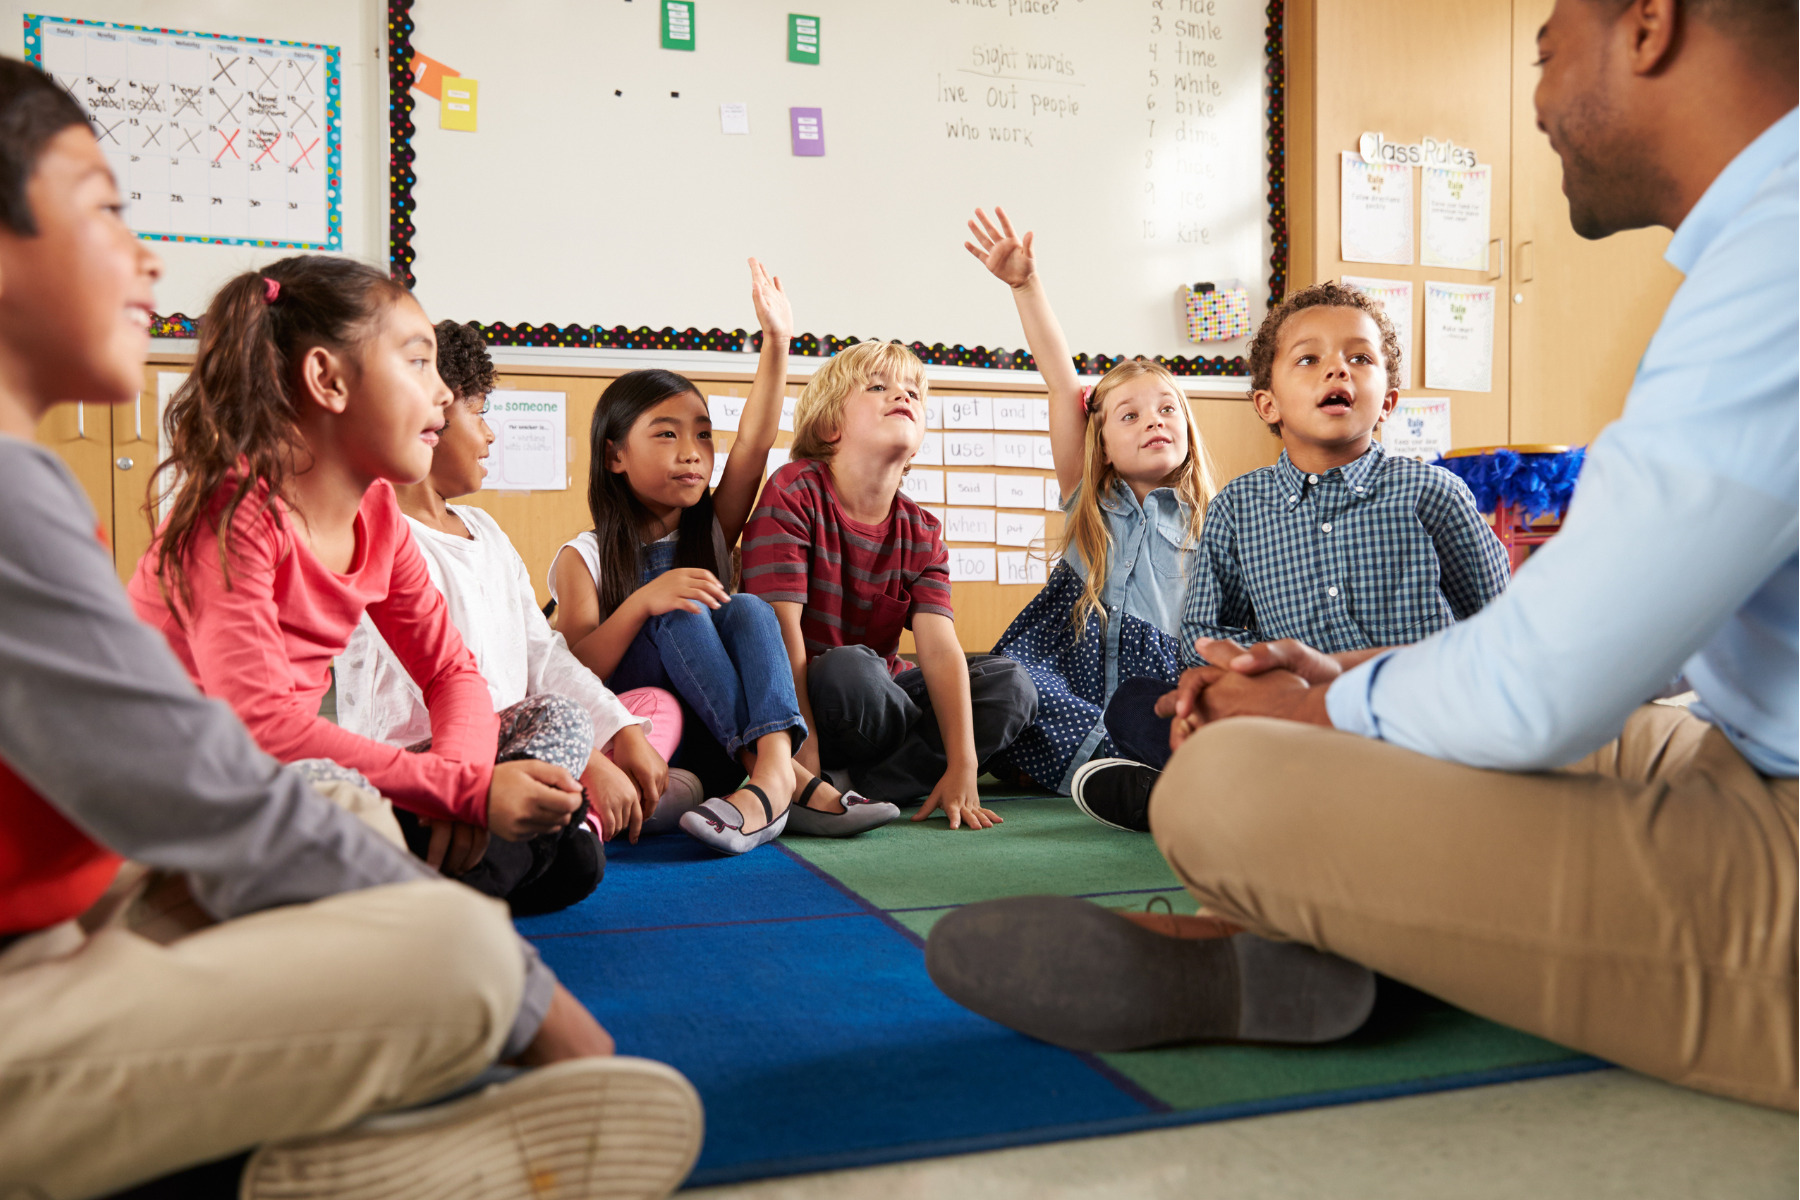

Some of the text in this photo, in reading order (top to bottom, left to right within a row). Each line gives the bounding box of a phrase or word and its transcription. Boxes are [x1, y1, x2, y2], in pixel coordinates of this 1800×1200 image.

[1009, 0, 1058, 18] place?
[1179, 0, 1216, 16] ride
[1174, 40, 1217, 68] time
[287, 59, 294, 69] 3
[1026, 53, 1075, 76] words
[1030, 93, 1079, 118] people
[1175, 92, 1216, 118] bike
[130, 118, 139, 126] 13
[989, 126, 1033, 148] work
[1175, 120, 1219, 147] dime
[1424, 138, 1476, 168] Rules
[211, 160, 223, 169] 22
[250, 162, 262, 171] 23
[1367, 173, 1384, 185] Rule
[505, 402, 558, 412] someone
[952, 398, 980, 422] get
[1000, 403, 1025, 419] and
[1407, 417, 1424, 427] Rule
[950, 441, 985, 458] use
[1004, 444, 1026, 459] up
[1011, 488, 1023, 497] no
[1006, 521, 1024, 535] put
[956, 550, 985, 576] too
[1007, 553, 1038, 581] her
